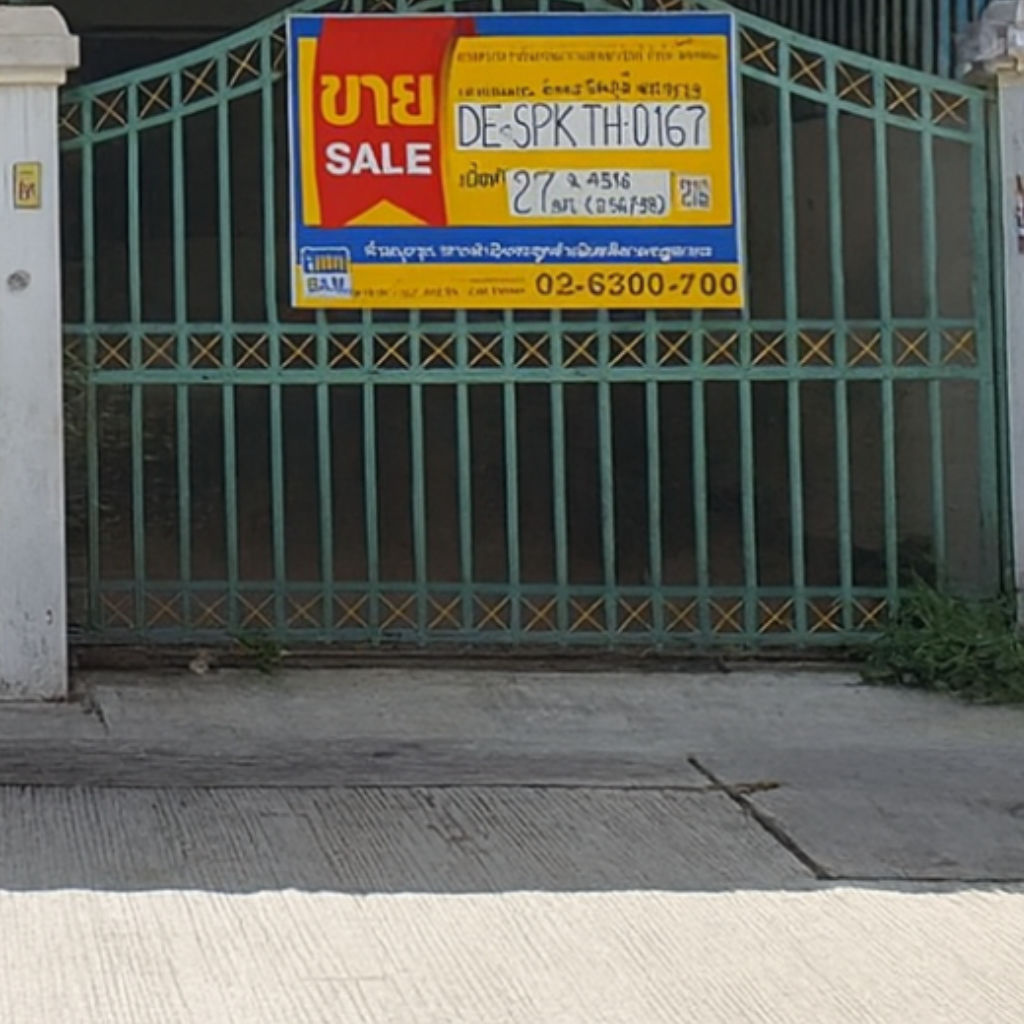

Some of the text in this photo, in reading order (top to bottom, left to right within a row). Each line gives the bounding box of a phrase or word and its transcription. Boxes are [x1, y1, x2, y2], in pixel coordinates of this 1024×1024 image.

[320, 74, 434, 126] ขาย
[325, 141, 432, 176] SALE
[535, 272, 738, 297] 02-6300-700
